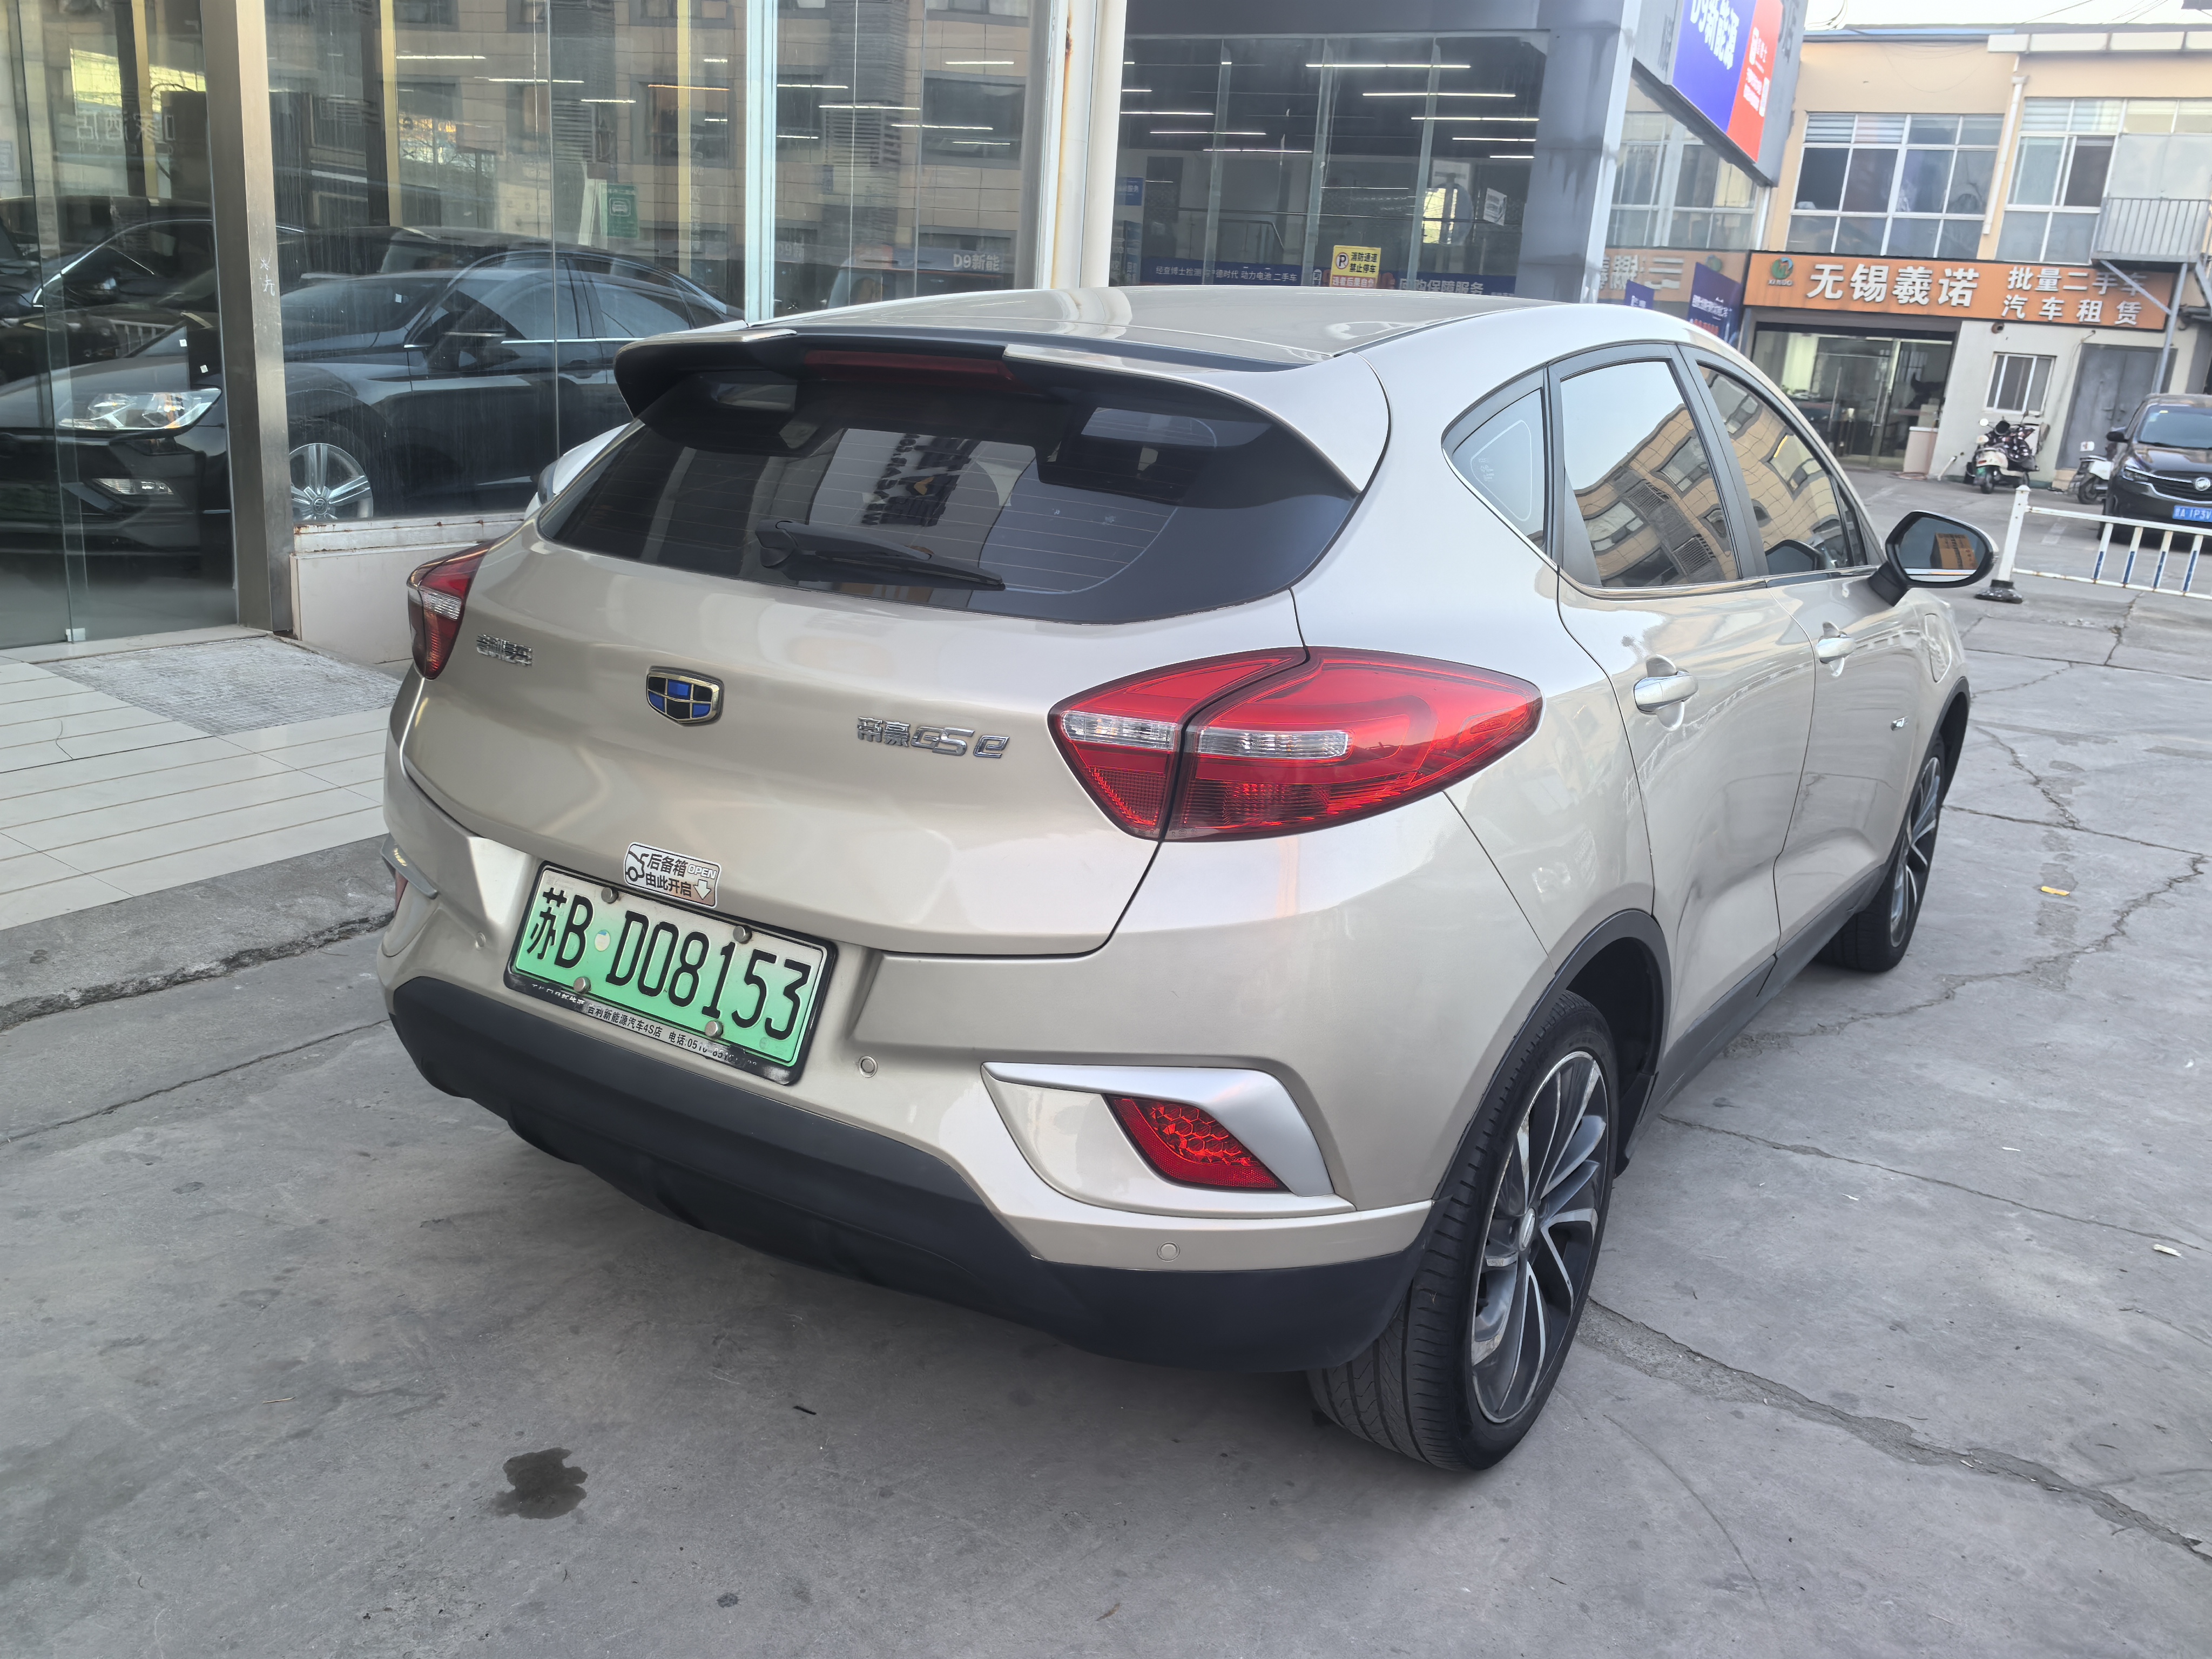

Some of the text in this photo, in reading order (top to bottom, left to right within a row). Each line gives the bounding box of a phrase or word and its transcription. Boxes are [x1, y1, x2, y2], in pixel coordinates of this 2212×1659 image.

[1350, 263, 1376, 274] 禁止停车
[1351, 252, 1378, 263] 消防通道
[2007, 266, 2147, 296] 批量二手车
[2001, 294, 2142, 326] 汽车租赁
[647, 853, 717, 879] 后备箱 OPEN
[645, 872, 692, 898] 由此开启
